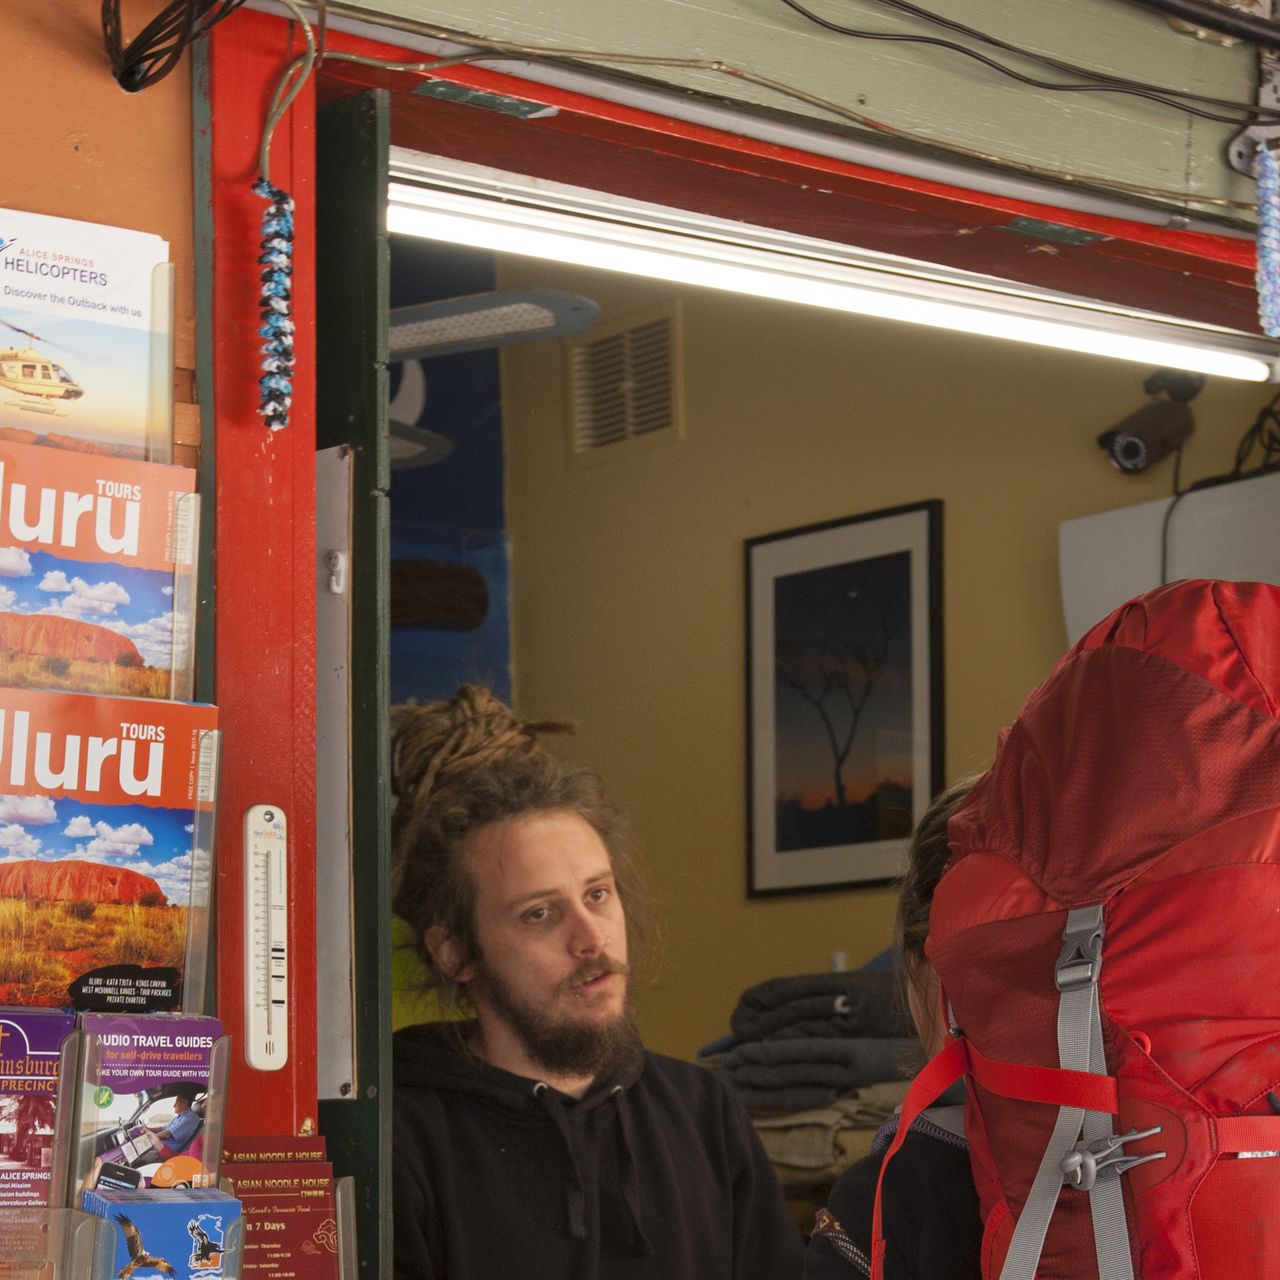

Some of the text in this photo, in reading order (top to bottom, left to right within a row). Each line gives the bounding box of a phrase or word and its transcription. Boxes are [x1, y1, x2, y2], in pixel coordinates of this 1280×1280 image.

[19, 247, 95, 268] ALICE SPRINGS
[4, 257, 109, 287] HELICOPTERS
[4, 285, 142, 318] Discover the Outback with us
[95, 479, 142, 501] TOURS
[120, 722, 165, 741] TOURS
[96, 1034, 213, 1048] AUDIO TRAVEL GUIDES
[236, 1178, 330, 1189] ASIAN NOODLE HOUSE
